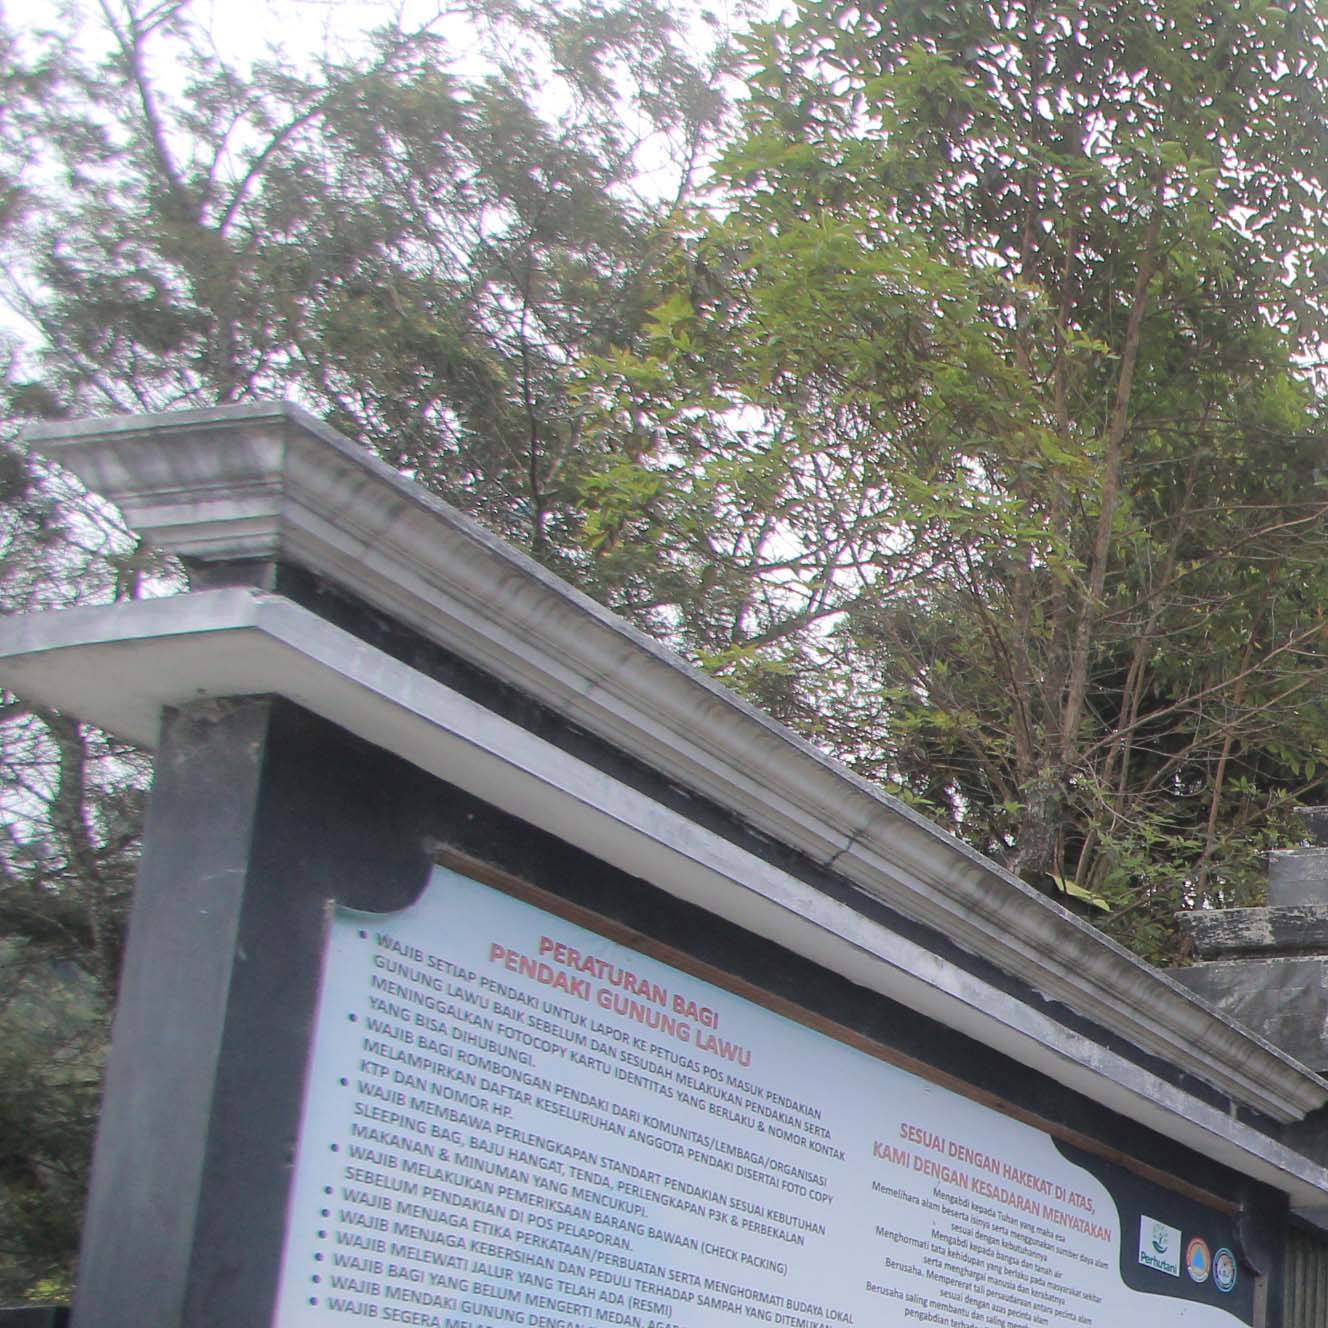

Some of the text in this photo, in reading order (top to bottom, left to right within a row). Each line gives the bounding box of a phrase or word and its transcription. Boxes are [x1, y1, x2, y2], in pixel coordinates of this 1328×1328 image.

[367, 995, 411, 1025] YANG
[414, 1012, 448, 1038] BISA
[374, 932, 821, 1121] WAJIB SETIAP PENDAKI UNTUK LAPOR KE PETUGAS POS MASUK PENDAKIAN
[488, 941, 752, 1068] PENDAKI GUNUNG LAWU
[537, 934, 719, 1031] PERATURAN BAGI
[369, 974, 845, 1162] MENINGGALKAN FOTOCOPY KARTU IDENTITAS YANG BERLAKU & NOMOR KONTAK
[372, 953, 831, 1140] GUNUNG LAWU BAIK SEBELUM DAN SESUDAH MELAKUKAN PENDAKIAN SERTA
[872, 1140, 1111, 1243] KAMI DENGAN KESADARAN MENYATAKAN
[899, 1122, 1095, 1216] SESUAI DENGAN HAKEKAT DI ATAS,
[326, 1296, 378, 1320] WAJIB
